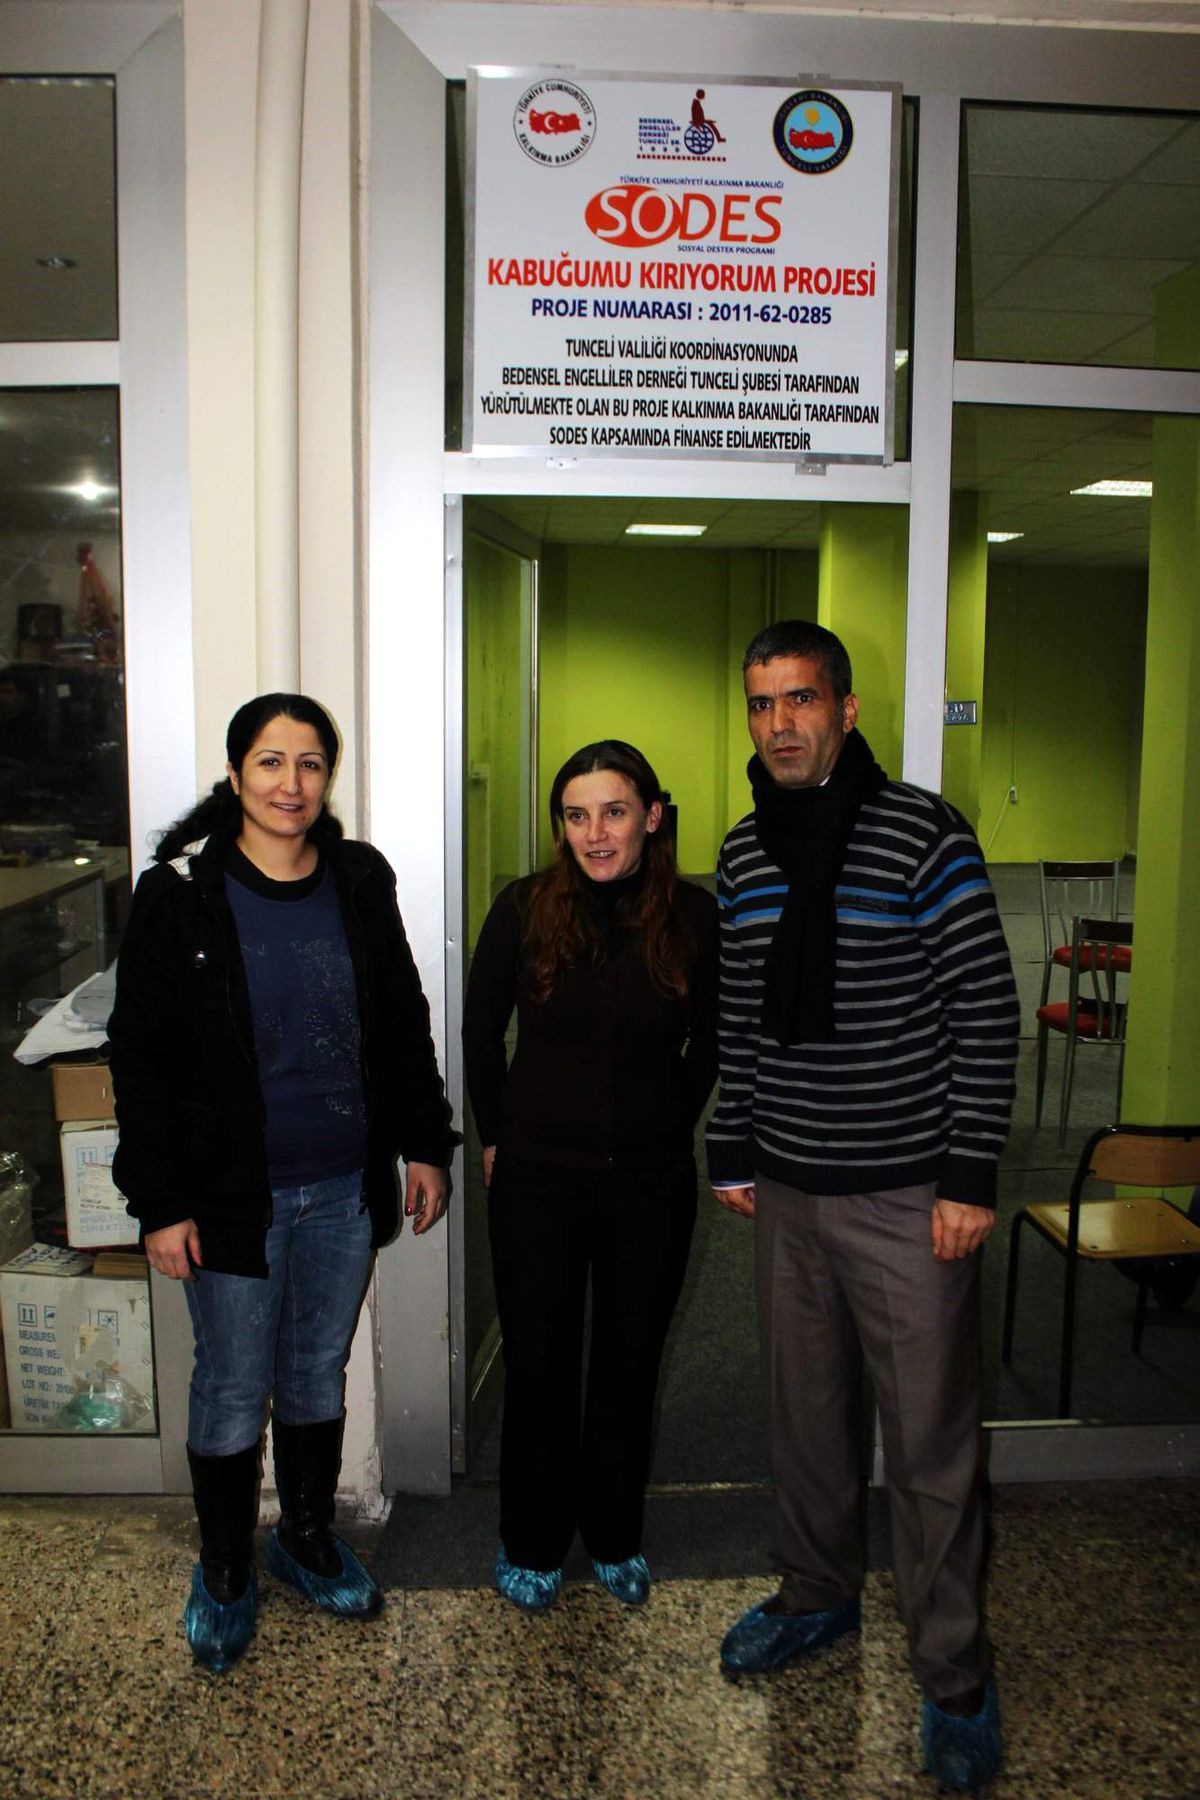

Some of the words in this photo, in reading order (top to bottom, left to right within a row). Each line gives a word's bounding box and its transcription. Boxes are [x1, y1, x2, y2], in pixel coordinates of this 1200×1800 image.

[620, 175, 650, 185] TÜRKİYE
[652, 177, 703, 187] CUMHURİYETİ
[704, 178, 743, 188] KALKINMA
[745, 179, 784, 189] BAKANLIĞI
[595, 188, 783, 244] SODES
[677, 244, 704, 253] SOSYAL
[706, 246, 734, 254] DESTEK
[735, 246, 775, 255] PROGRAMI
[489, 253, 631, 288] KABUĞUMU
[640, 263, 776, 292] KIRIYORUM
[784, 262, 875, 296] PROJESİ
[532, 299, 587, 317] PROJE
[594, 300, 691, 320] NUMARASI
[710, 303, 831, 324] 2011-62-0285
[566, 339, 614, 357] TUNCELİ
[618, 336, 666, 358] VALİLİĞİ
[670, 338, 798, 362] KOORDİNASYONUNDA
[503, 367, 560, 385] BEDENSEL
[565, 365, 633, 387] ENGELLİLER
[637, 366, 686, 388] DERNEĞİ
[690, 368, 738, 390] TUNCELİ
[742, 369, 780, 395] ŞUBESİ
[784, 374, 859, 393] TARAFINDAN
[481, 392, 572, 415] YÜRÜTÜLMEKTE
[577, 398, 609, 416] OLAN
[613, 399, 629, 416] BU
[633, 400, 668, 417] PROJE
[672, 400, 735, 419] KALKINMA
[739, 399, 801, 421] BAKANLIĞI
[804, 404, 879, 423] TARAFINDAN
[550, 427, 587, 444] SODES
[592, 428, 670, 446] KAPSAMINDA
[674, 425, 723, 448] FİNANSE
[727, 426, 810, 450] EDİLMEKTEDİR
